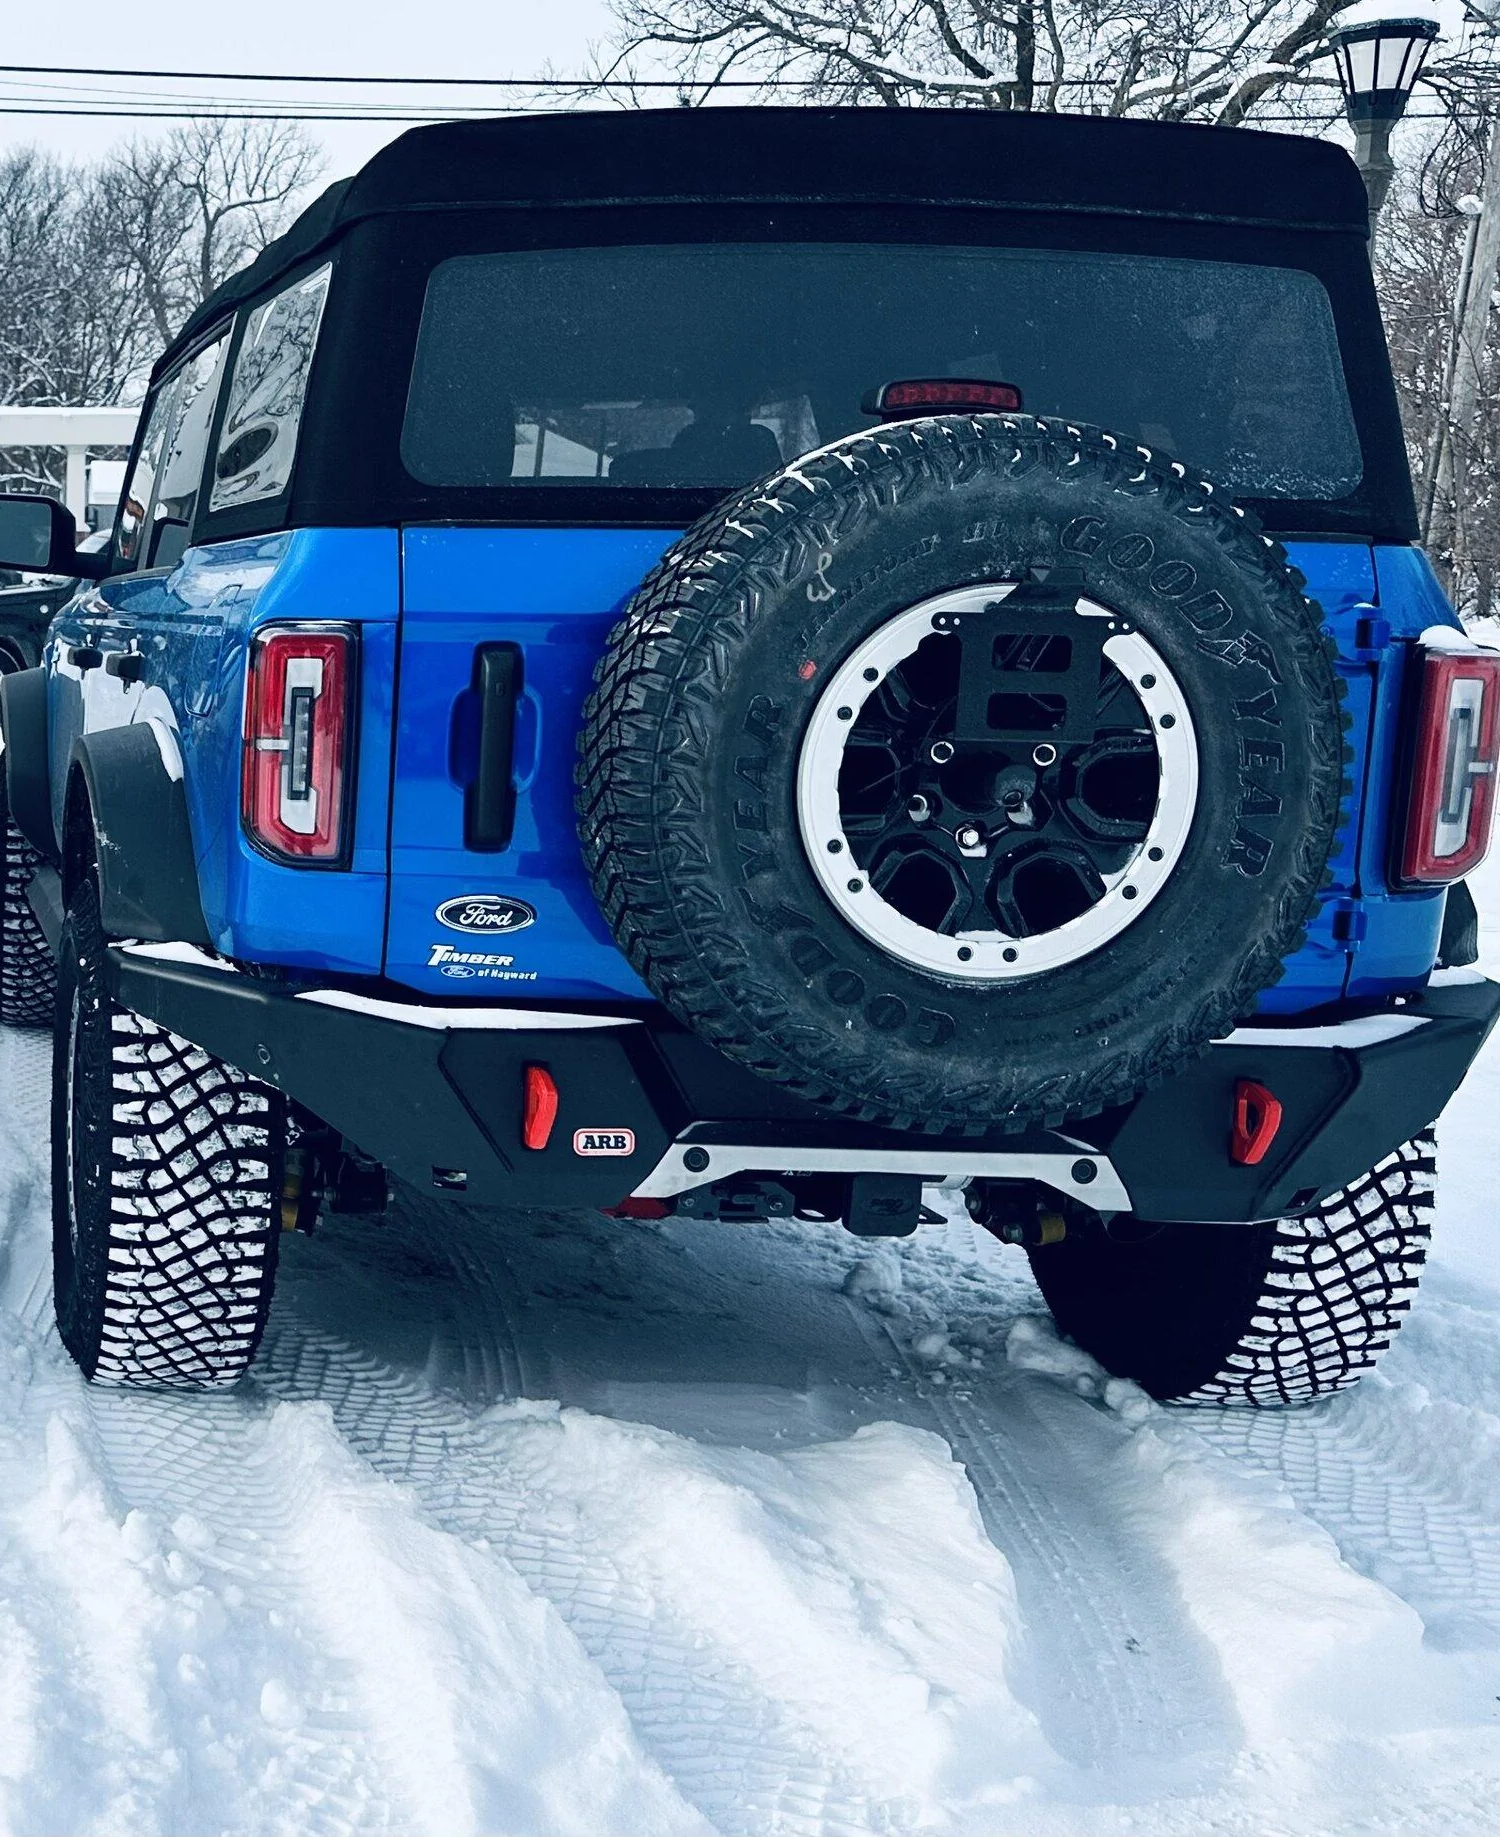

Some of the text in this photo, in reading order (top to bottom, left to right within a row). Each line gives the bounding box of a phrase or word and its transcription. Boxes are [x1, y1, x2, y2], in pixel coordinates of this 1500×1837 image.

[1060, 515, 1287, 878] GOODYEAR
[460, 903, 514, 926] Ford
[477, 969, 489, 978] of
[490, 968, 538, 980] Hayward
[582, 1135, 627, 1150] ARB
